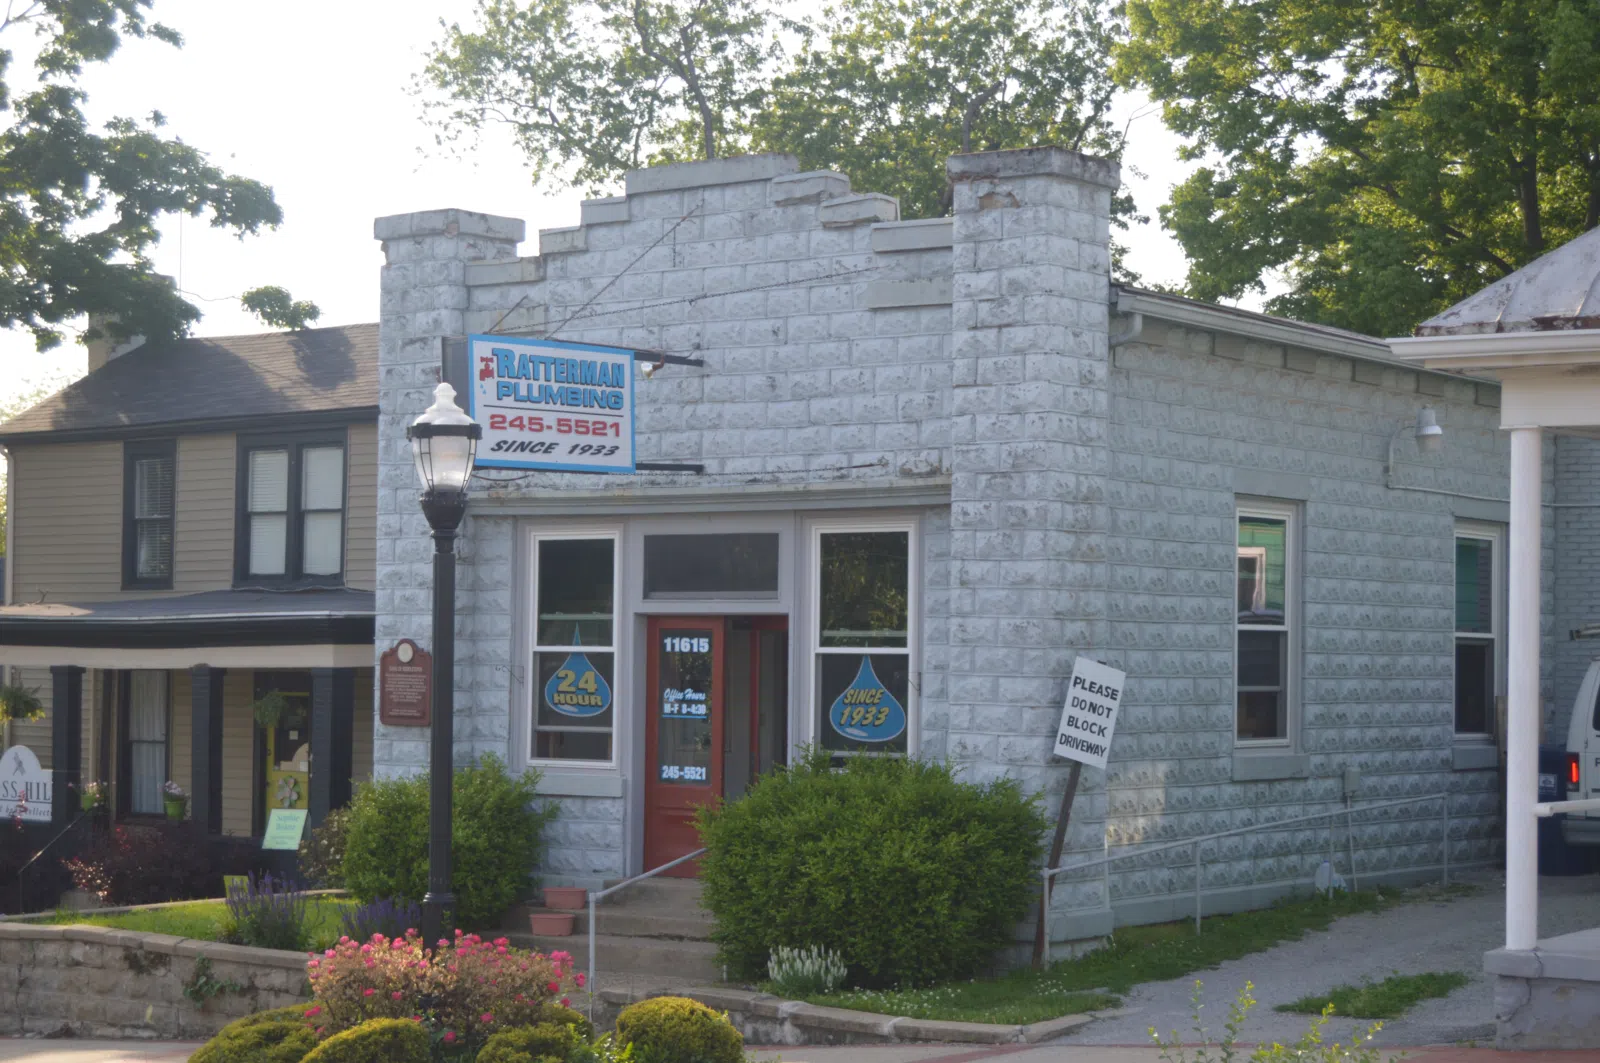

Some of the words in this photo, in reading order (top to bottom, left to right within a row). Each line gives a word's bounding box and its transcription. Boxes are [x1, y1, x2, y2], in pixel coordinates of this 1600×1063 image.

[492, 348, 625, 388] RATTERMAN
[496, 381, 624, 410] PLUMBING
[489, 414, 621, 437] 245-5521
[490, 439, 559, 454] SINCE
[567, 443, 620, 456] 1933
[663, 636, 709, 653] 11615
[557, 669, 598, 693] 24
[1073, 676, 1119, 701] PLEASE
[553, 692, 602, 706] HOUR
[664, 688, 684, 702] Office
[684, 688, 706, 701] Hours
[843, 688, 884, 705] SINCE
[664, 703, 679, 714] M-F
[840, 706, 890, 727] 1933
[1071, 696, 1087, 711] DO
[1088, 701, 1113, 718] NOT
[1067, 715, 1108, 737] BLOCK
[1059, 733, 1107, 757] DRIVEWAY
[662, 765, 707, 781] 245-5521
